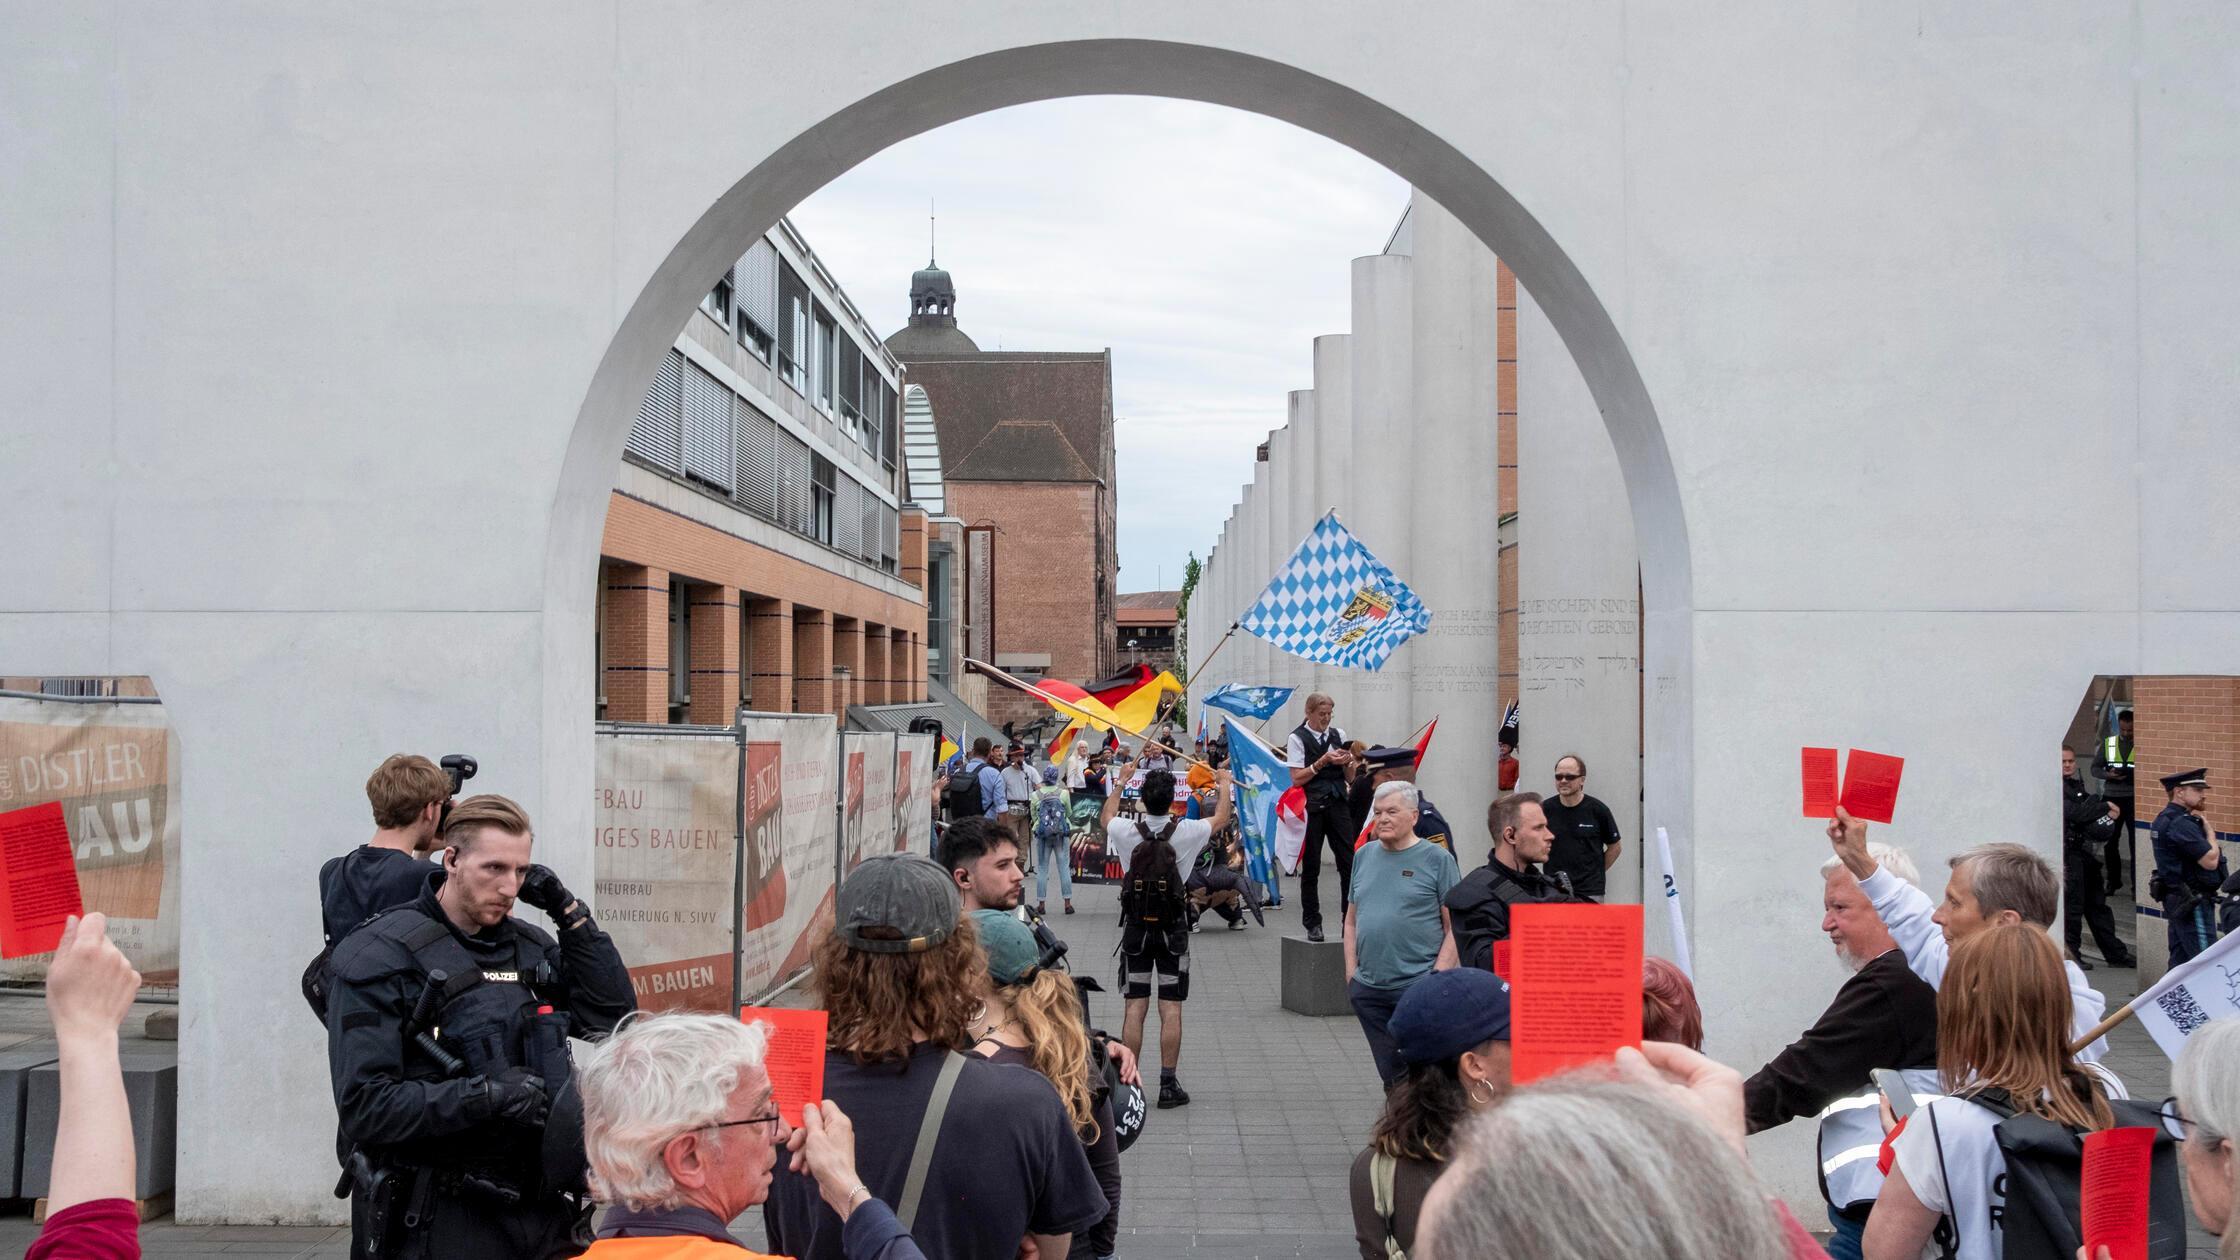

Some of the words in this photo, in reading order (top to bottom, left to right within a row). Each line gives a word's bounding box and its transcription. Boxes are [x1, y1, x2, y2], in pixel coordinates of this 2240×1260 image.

[76, 798, 153, 860] AU
[595, 827, 640, 848] IGES
[650, 828, 719, 850] BAUEN
[595, 882, 653, 896] NIEURBAU
[596, 909, 669, 923] NSANIERUNG
[482, 971, 518, 981] POLIZEI
[651, 965, 715, 994] BAUEN
